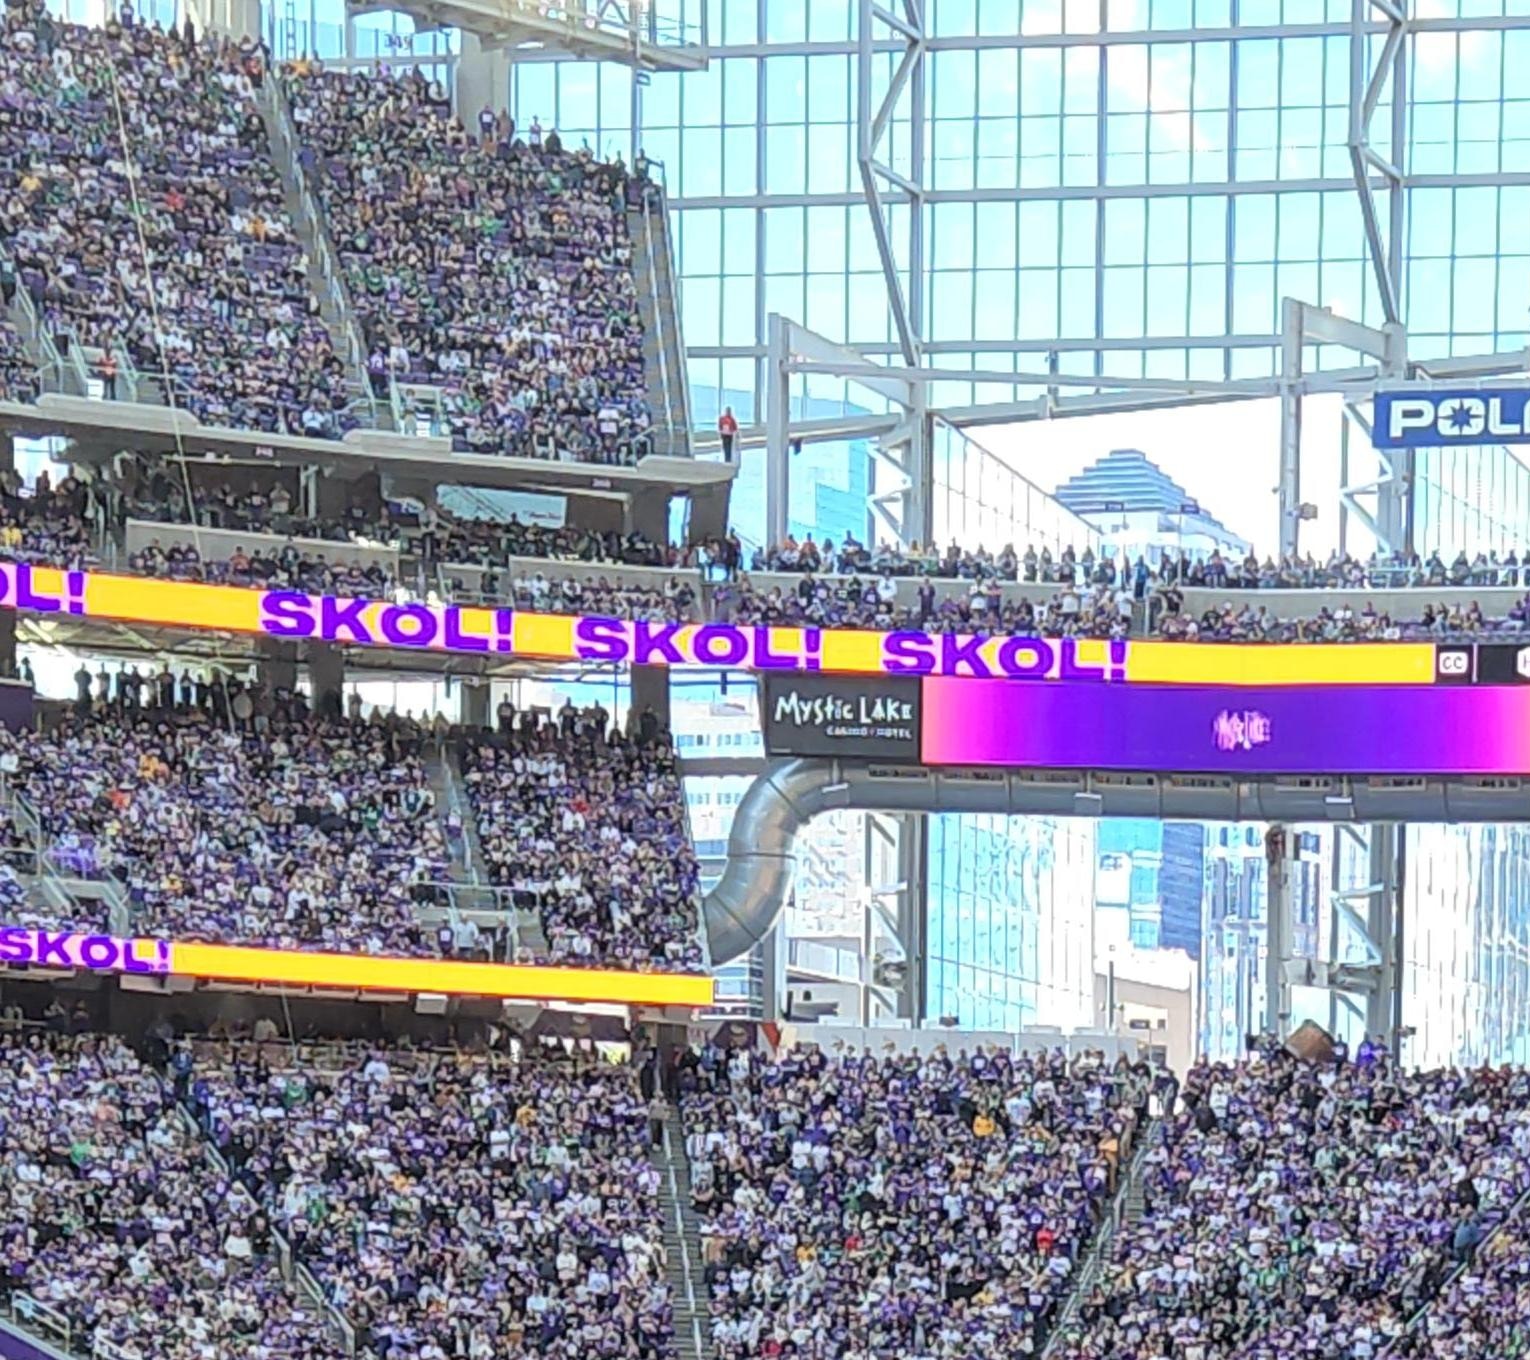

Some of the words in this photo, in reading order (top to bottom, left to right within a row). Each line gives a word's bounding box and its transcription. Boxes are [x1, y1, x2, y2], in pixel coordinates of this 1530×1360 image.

[0, 563, 86, 615] L!
[259, 588, 514, 653] SKOL!
[575, 615, 821, 671] SKOL!
[882, 630, 1128, 682] SKOL!
[0, 926, 169, 974] SKOL!
